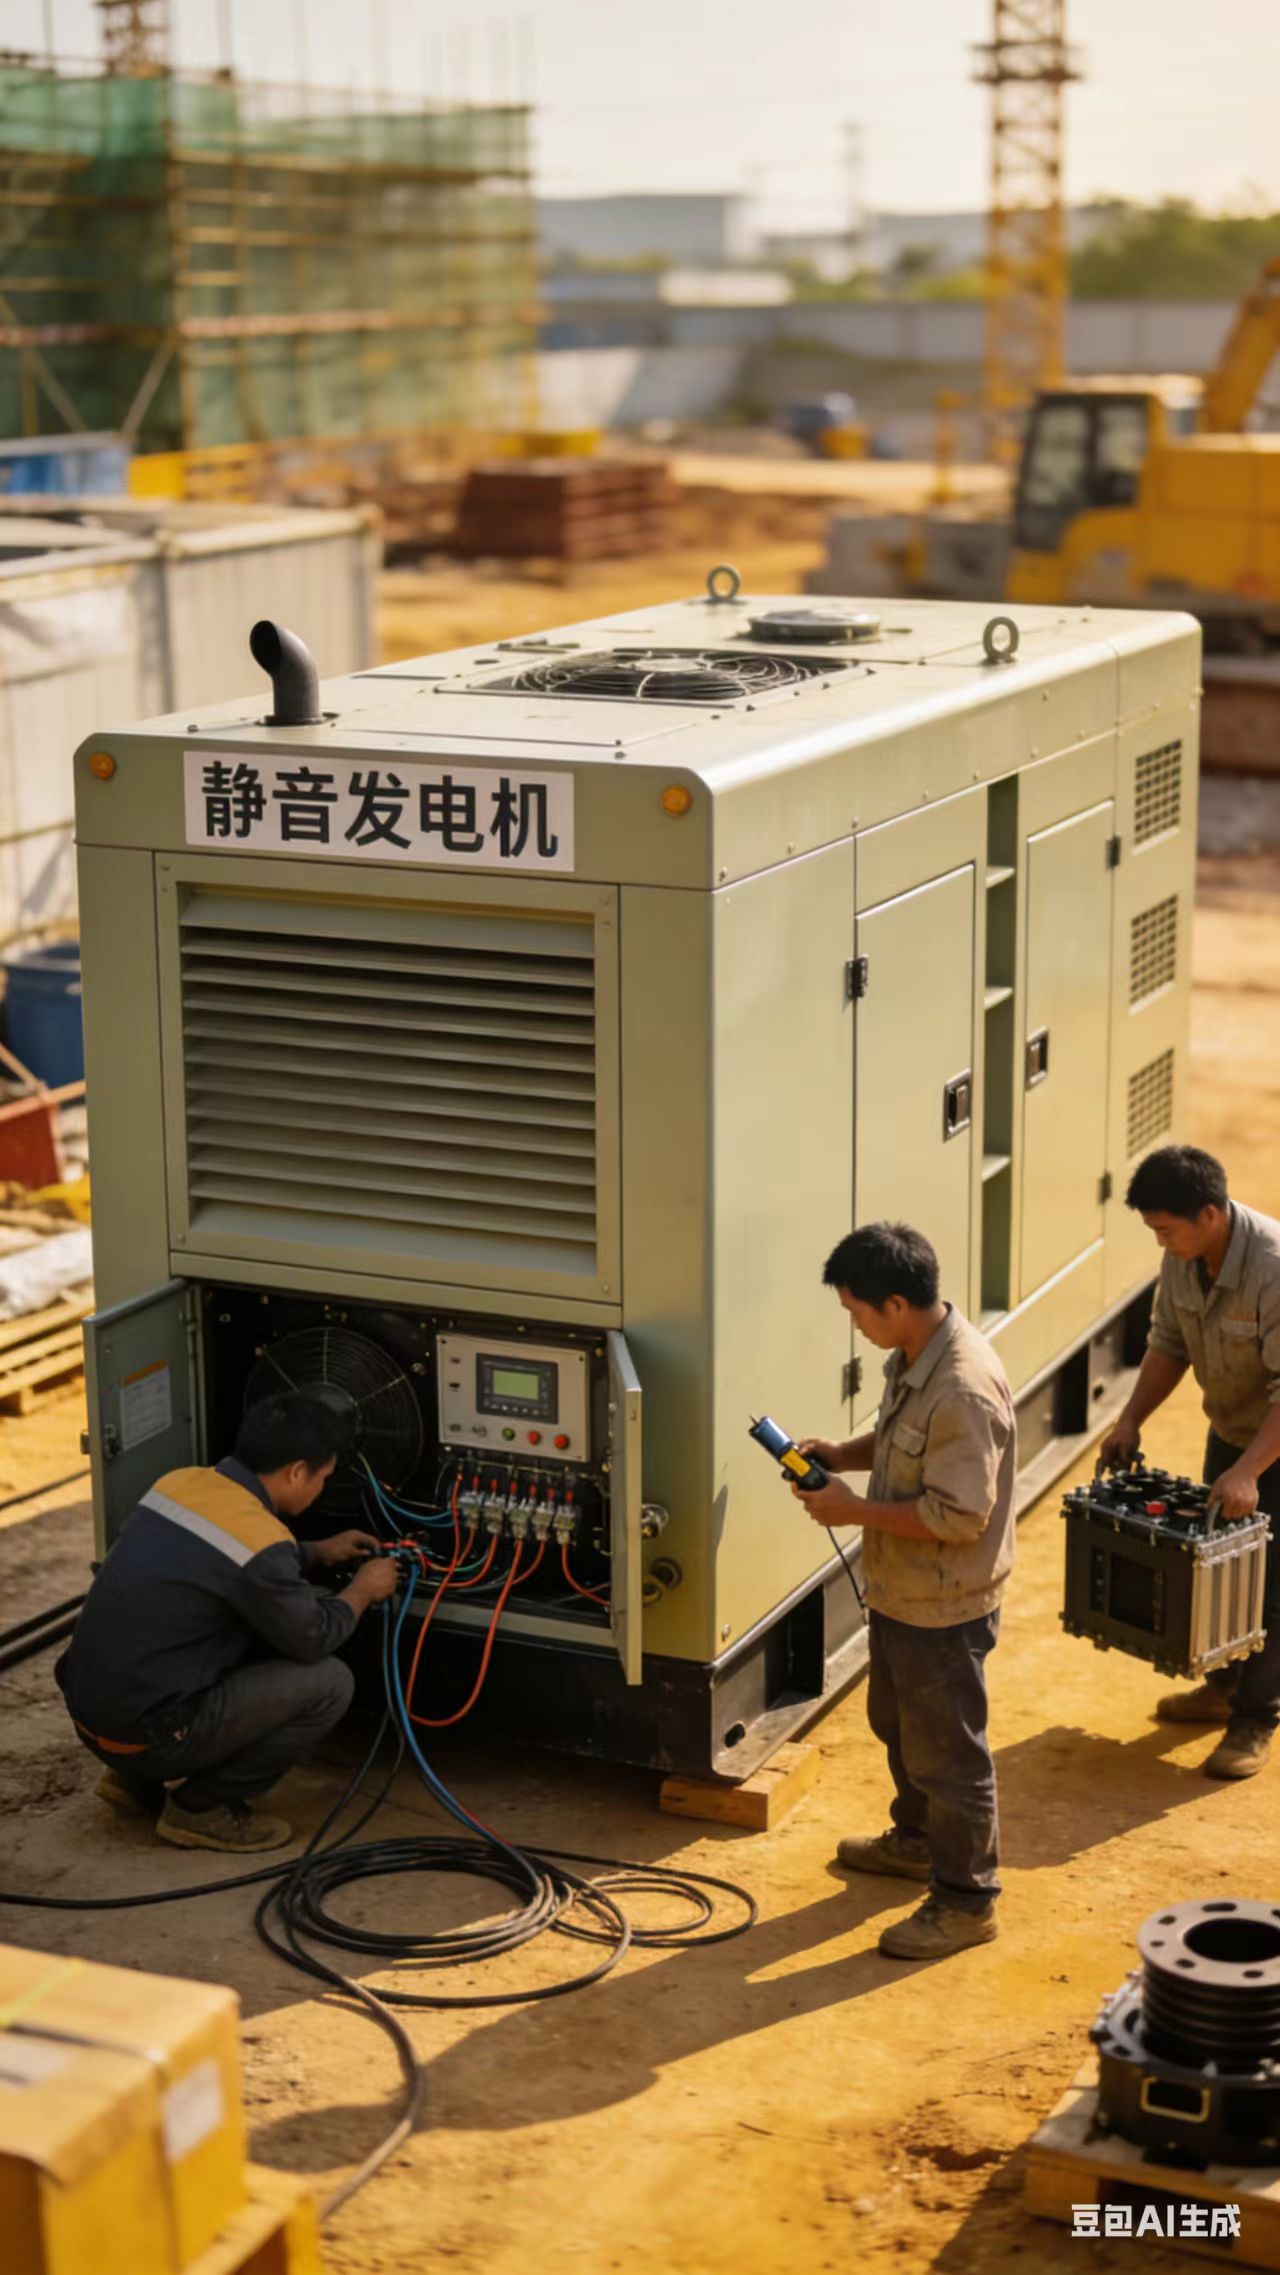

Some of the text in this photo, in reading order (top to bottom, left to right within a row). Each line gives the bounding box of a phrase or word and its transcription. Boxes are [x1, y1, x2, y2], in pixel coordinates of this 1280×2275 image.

[201, 761, 558, 858] 静音发电机
